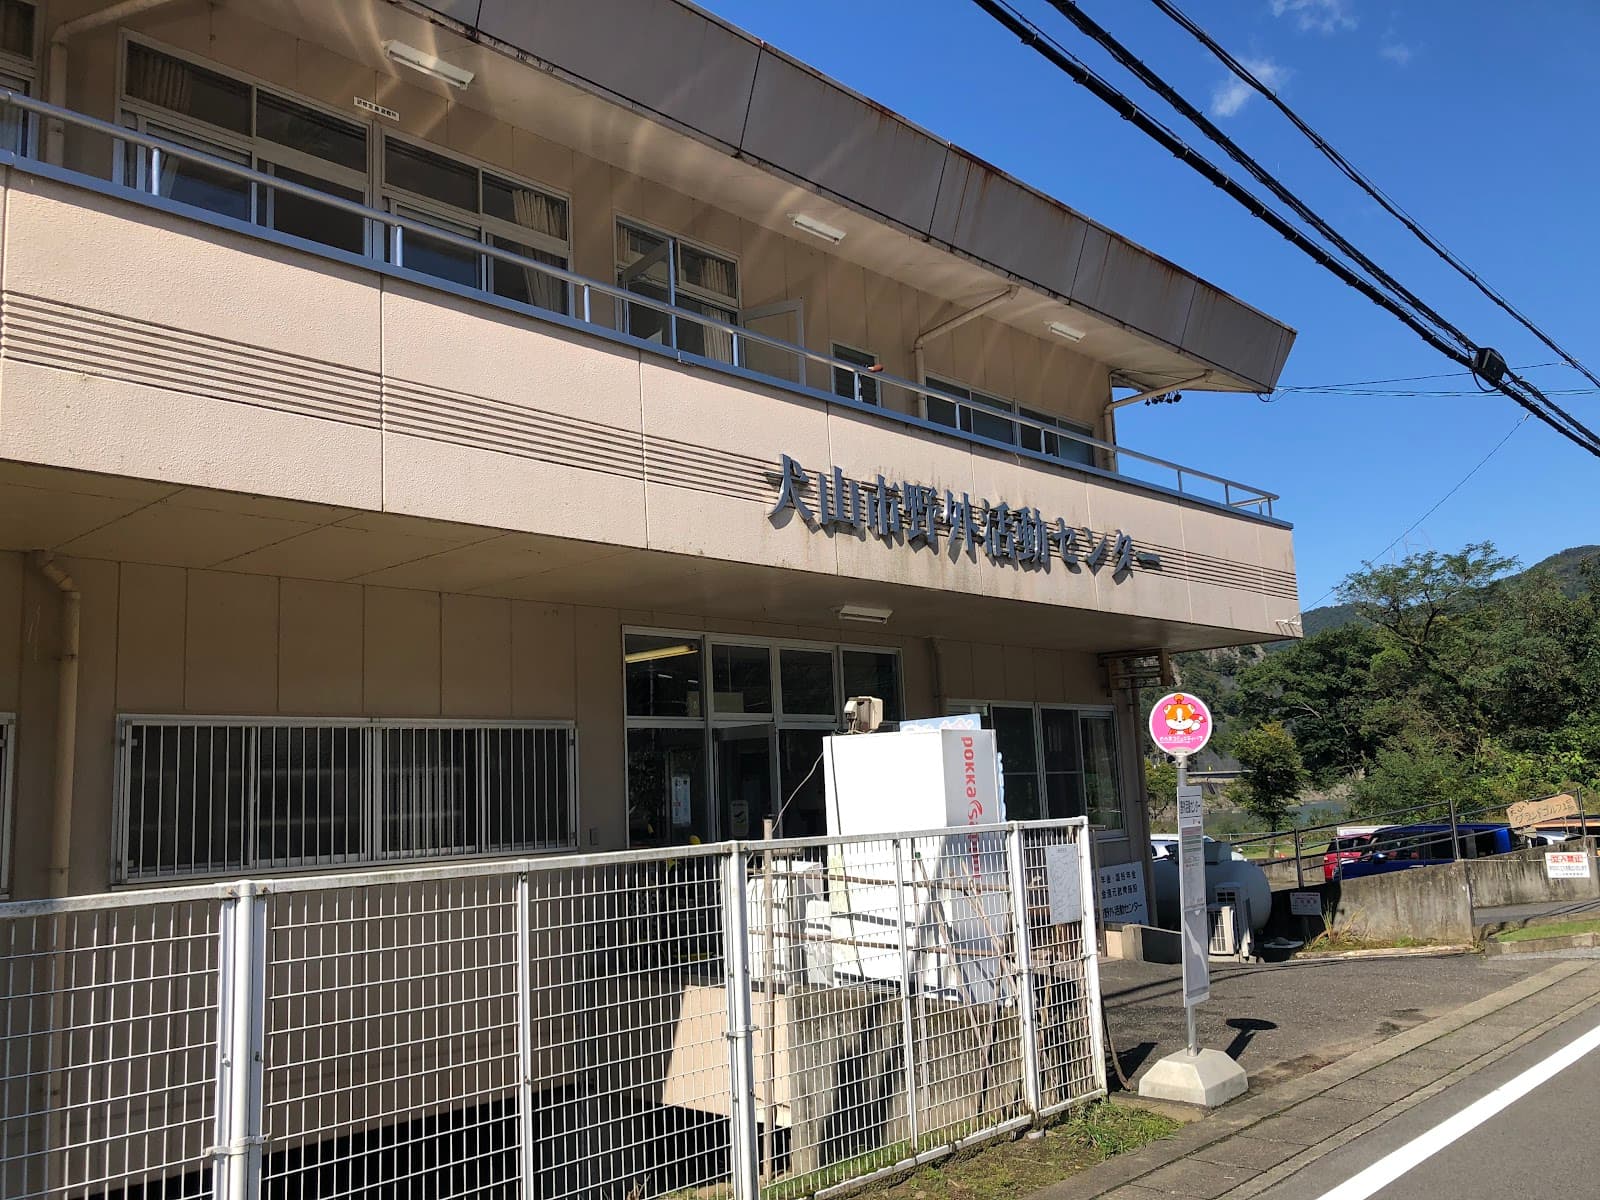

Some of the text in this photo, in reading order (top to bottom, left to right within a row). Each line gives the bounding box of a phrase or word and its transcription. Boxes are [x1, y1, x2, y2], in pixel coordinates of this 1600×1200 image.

[766, 454, 1160, 575] 犬山市野外活動センター
